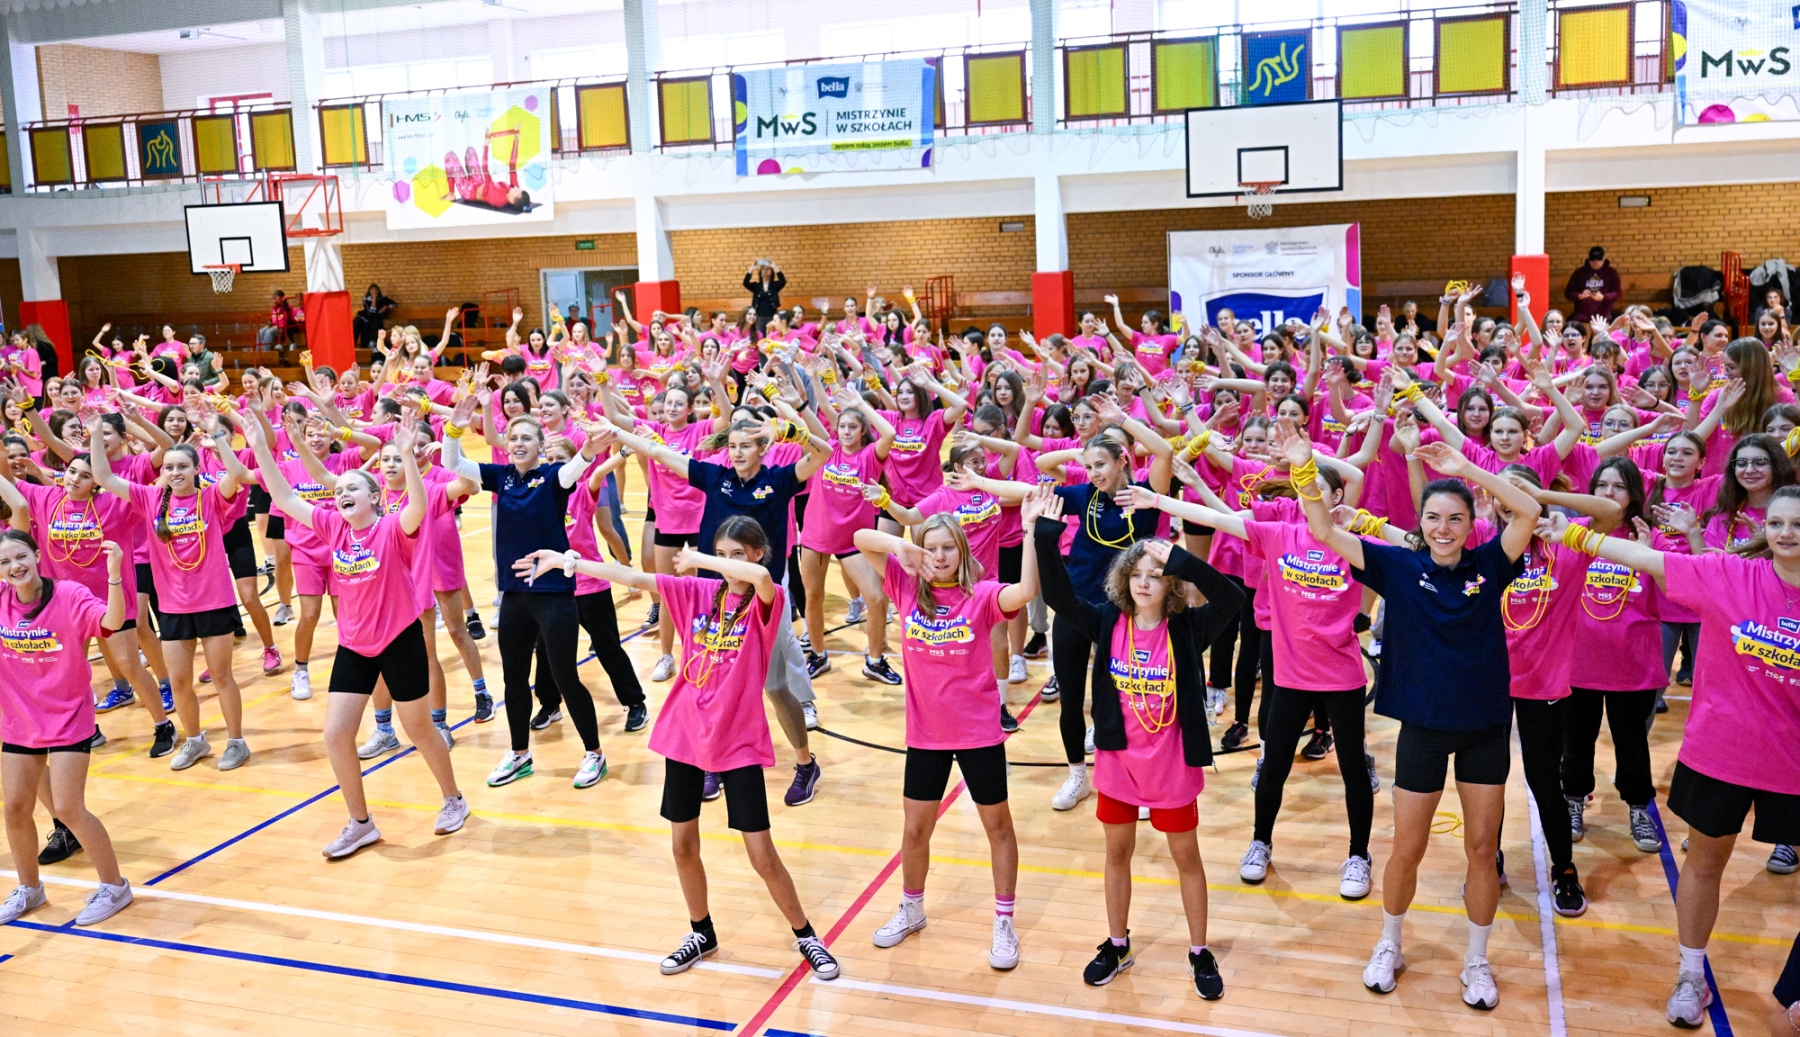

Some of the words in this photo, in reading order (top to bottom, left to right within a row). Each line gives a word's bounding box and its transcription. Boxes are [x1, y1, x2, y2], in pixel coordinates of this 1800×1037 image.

[1701, 47, 1791, 78] MwS
[820, 81, 845, 92] bella
[396, 112, 431, 123] HMS
[836, 108, 907, 120] MISTRZYNIE
[757, 112, 817, 138] MwS
[836, 124, 847, 133] W
[850, 120, 912, 133] SZKOŁACH
[1265, 270, 1295, 278] GŁÓWNY
[1286, 553, 1339, 572] Mistrzynie
[1286, 570, 1293, 578] w
[1294, 573, 1338, 586] szkołach
[1781, 621, 1797, 629] bella
[911, 628, 920, 636] w
[921, 628, 964, 641] szkołach
[11, 640, 51, 649] szkołach
[1743, 642, 1755, 652] w
